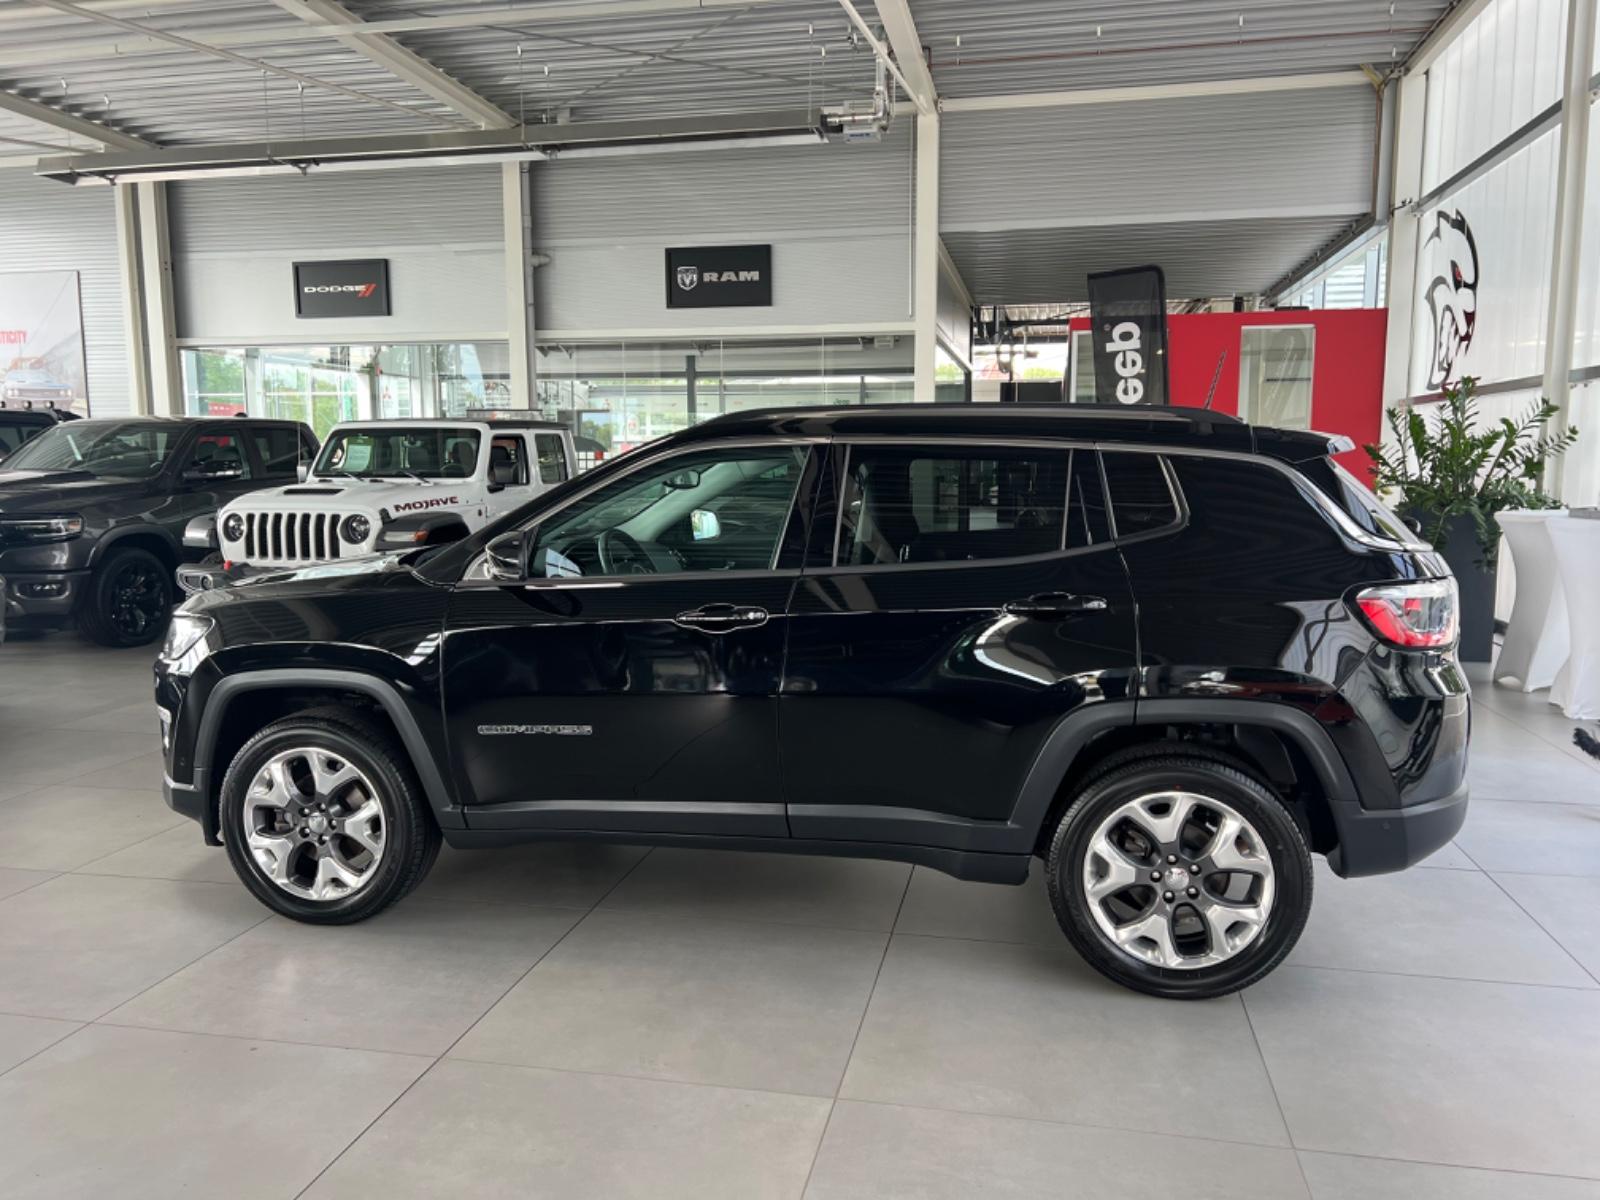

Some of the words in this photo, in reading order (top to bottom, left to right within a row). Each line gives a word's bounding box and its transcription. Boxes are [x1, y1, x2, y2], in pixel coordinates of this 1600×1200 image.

[703, 271, 760, 282] RAM
[304, 285, 366, 293] DODGE
[0, 330, 27, 344] TICITY
[393, 496, 459, 512] MOJAVE
